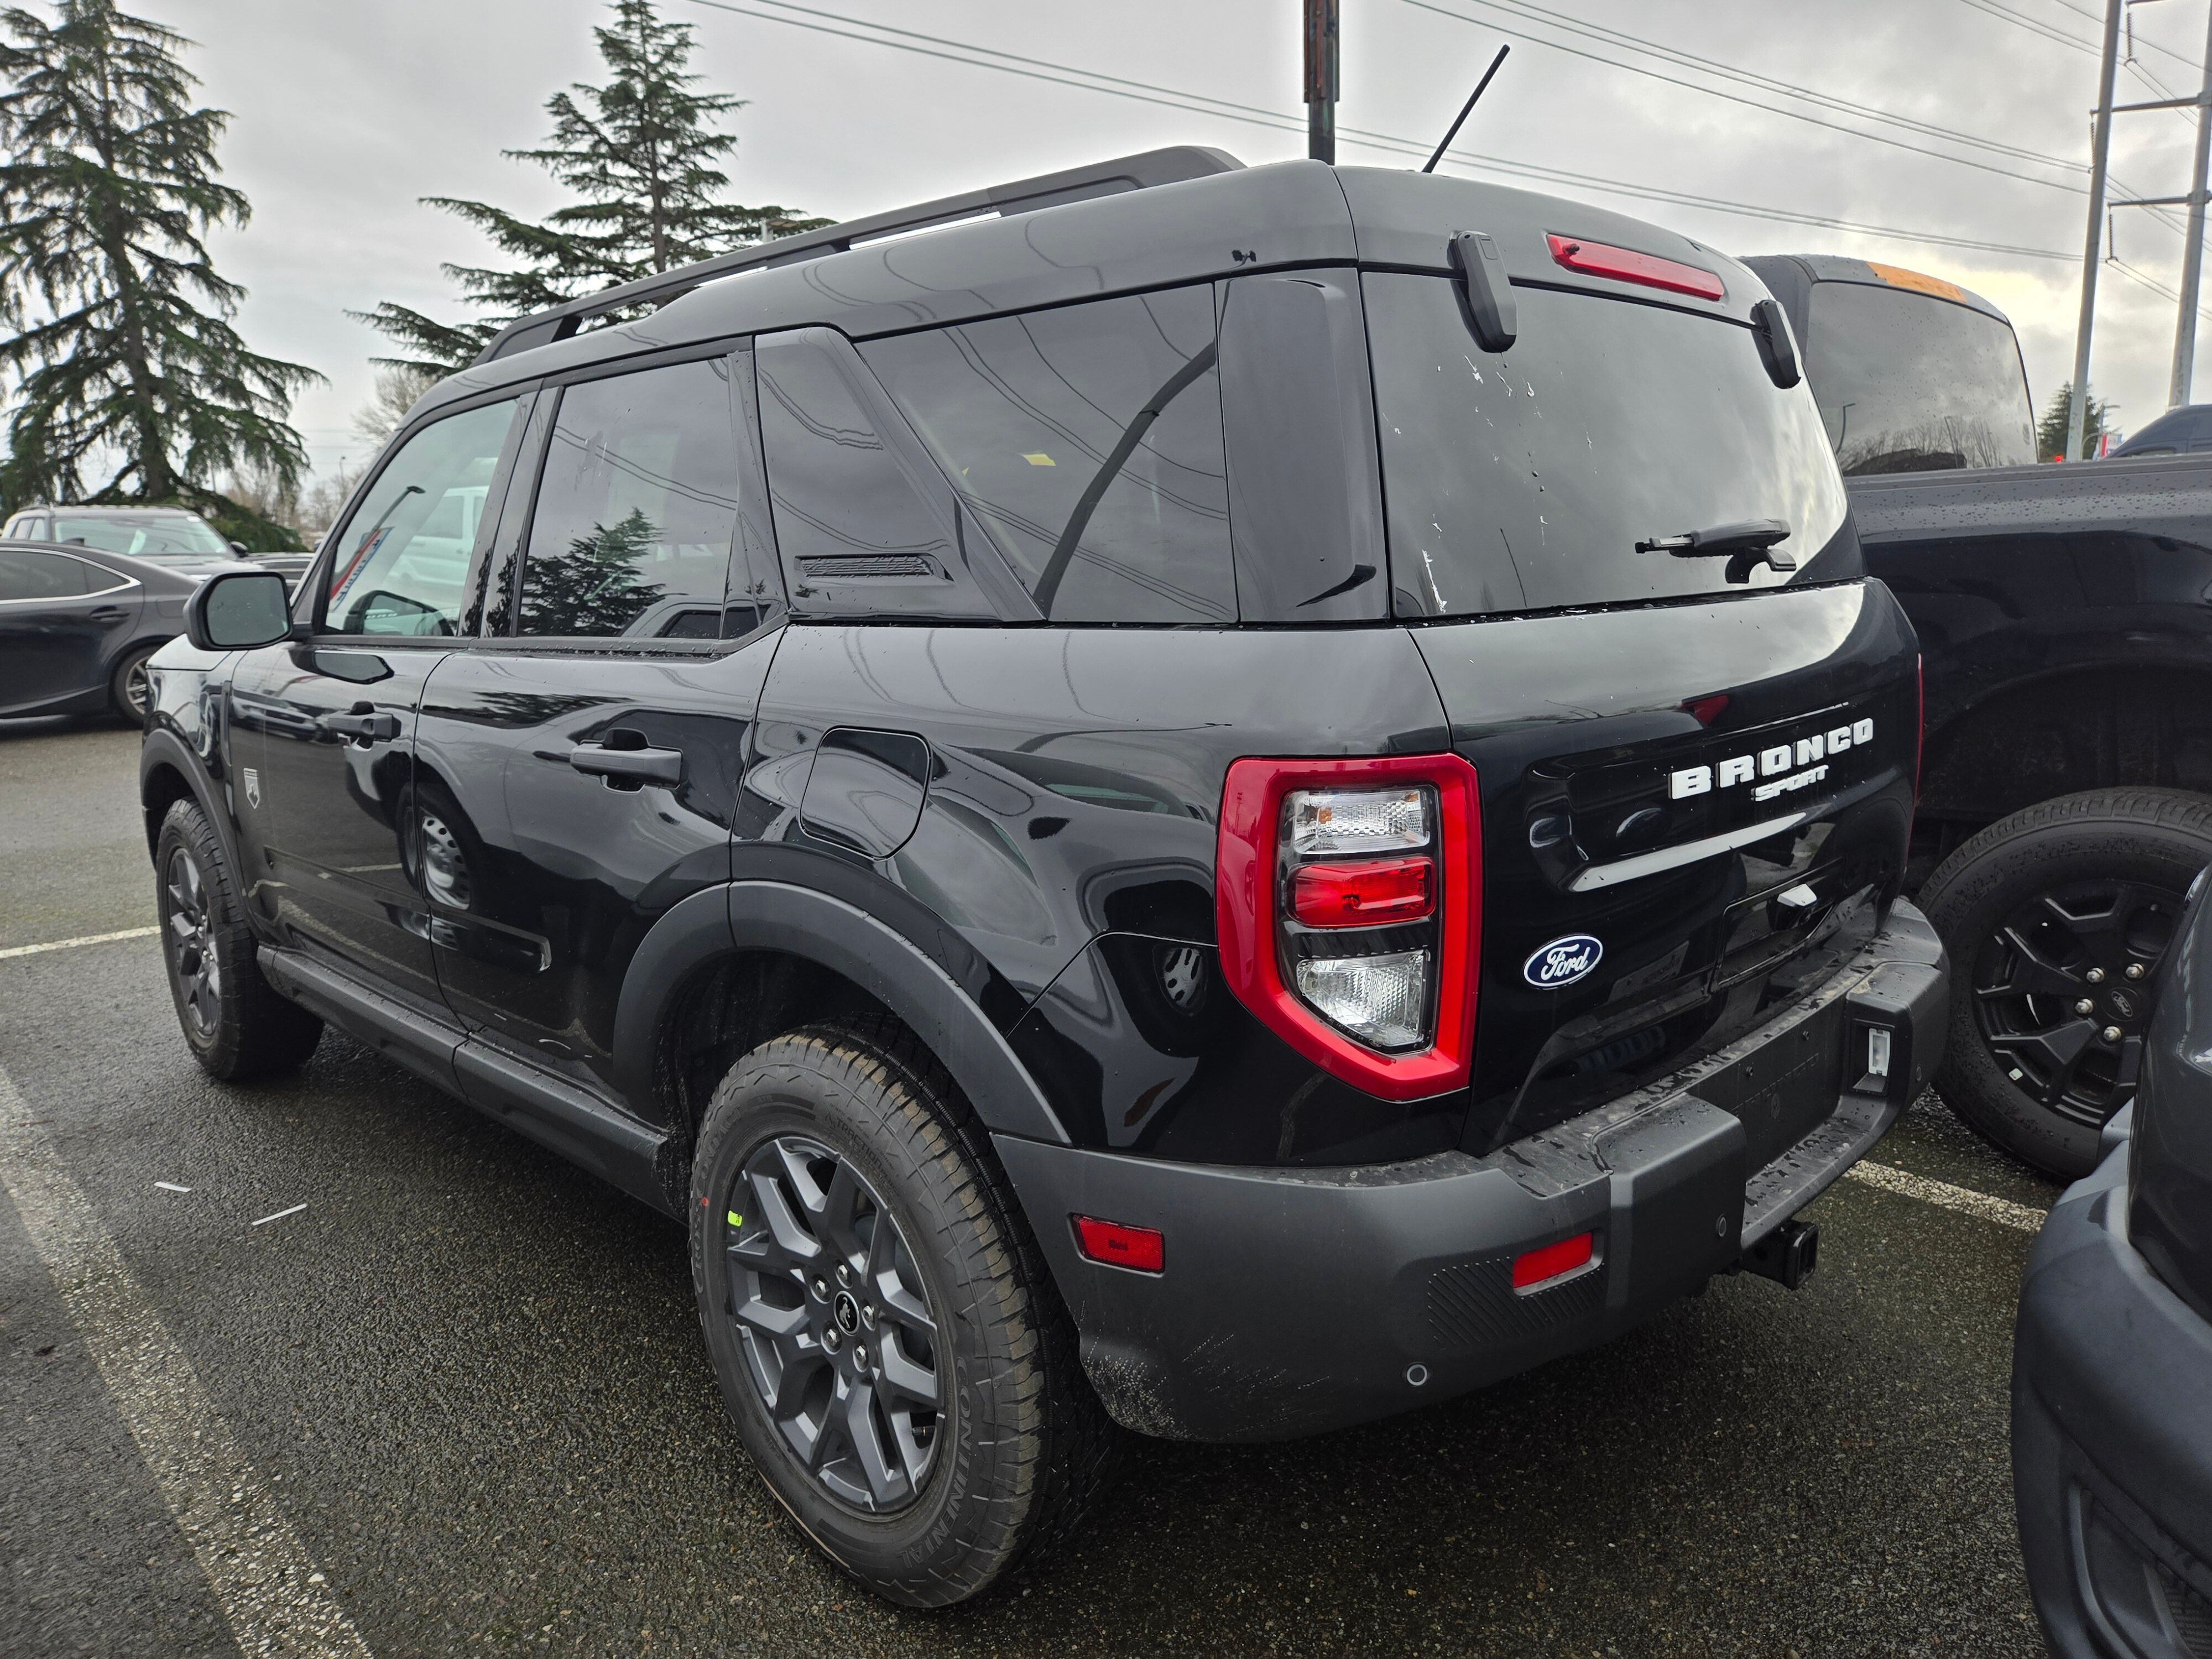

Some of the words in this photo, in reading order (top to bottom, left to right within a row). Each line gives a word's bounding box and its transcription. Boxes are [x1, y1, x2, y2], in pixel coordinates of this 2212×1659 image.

[1669, 718, 1874, 800] BRONCO
[1752, 765, 1829, 801] SPORT
[1541, 943, 1590, 980] Ford
[897, 1357, 972, 1568] CONTINENTAL
